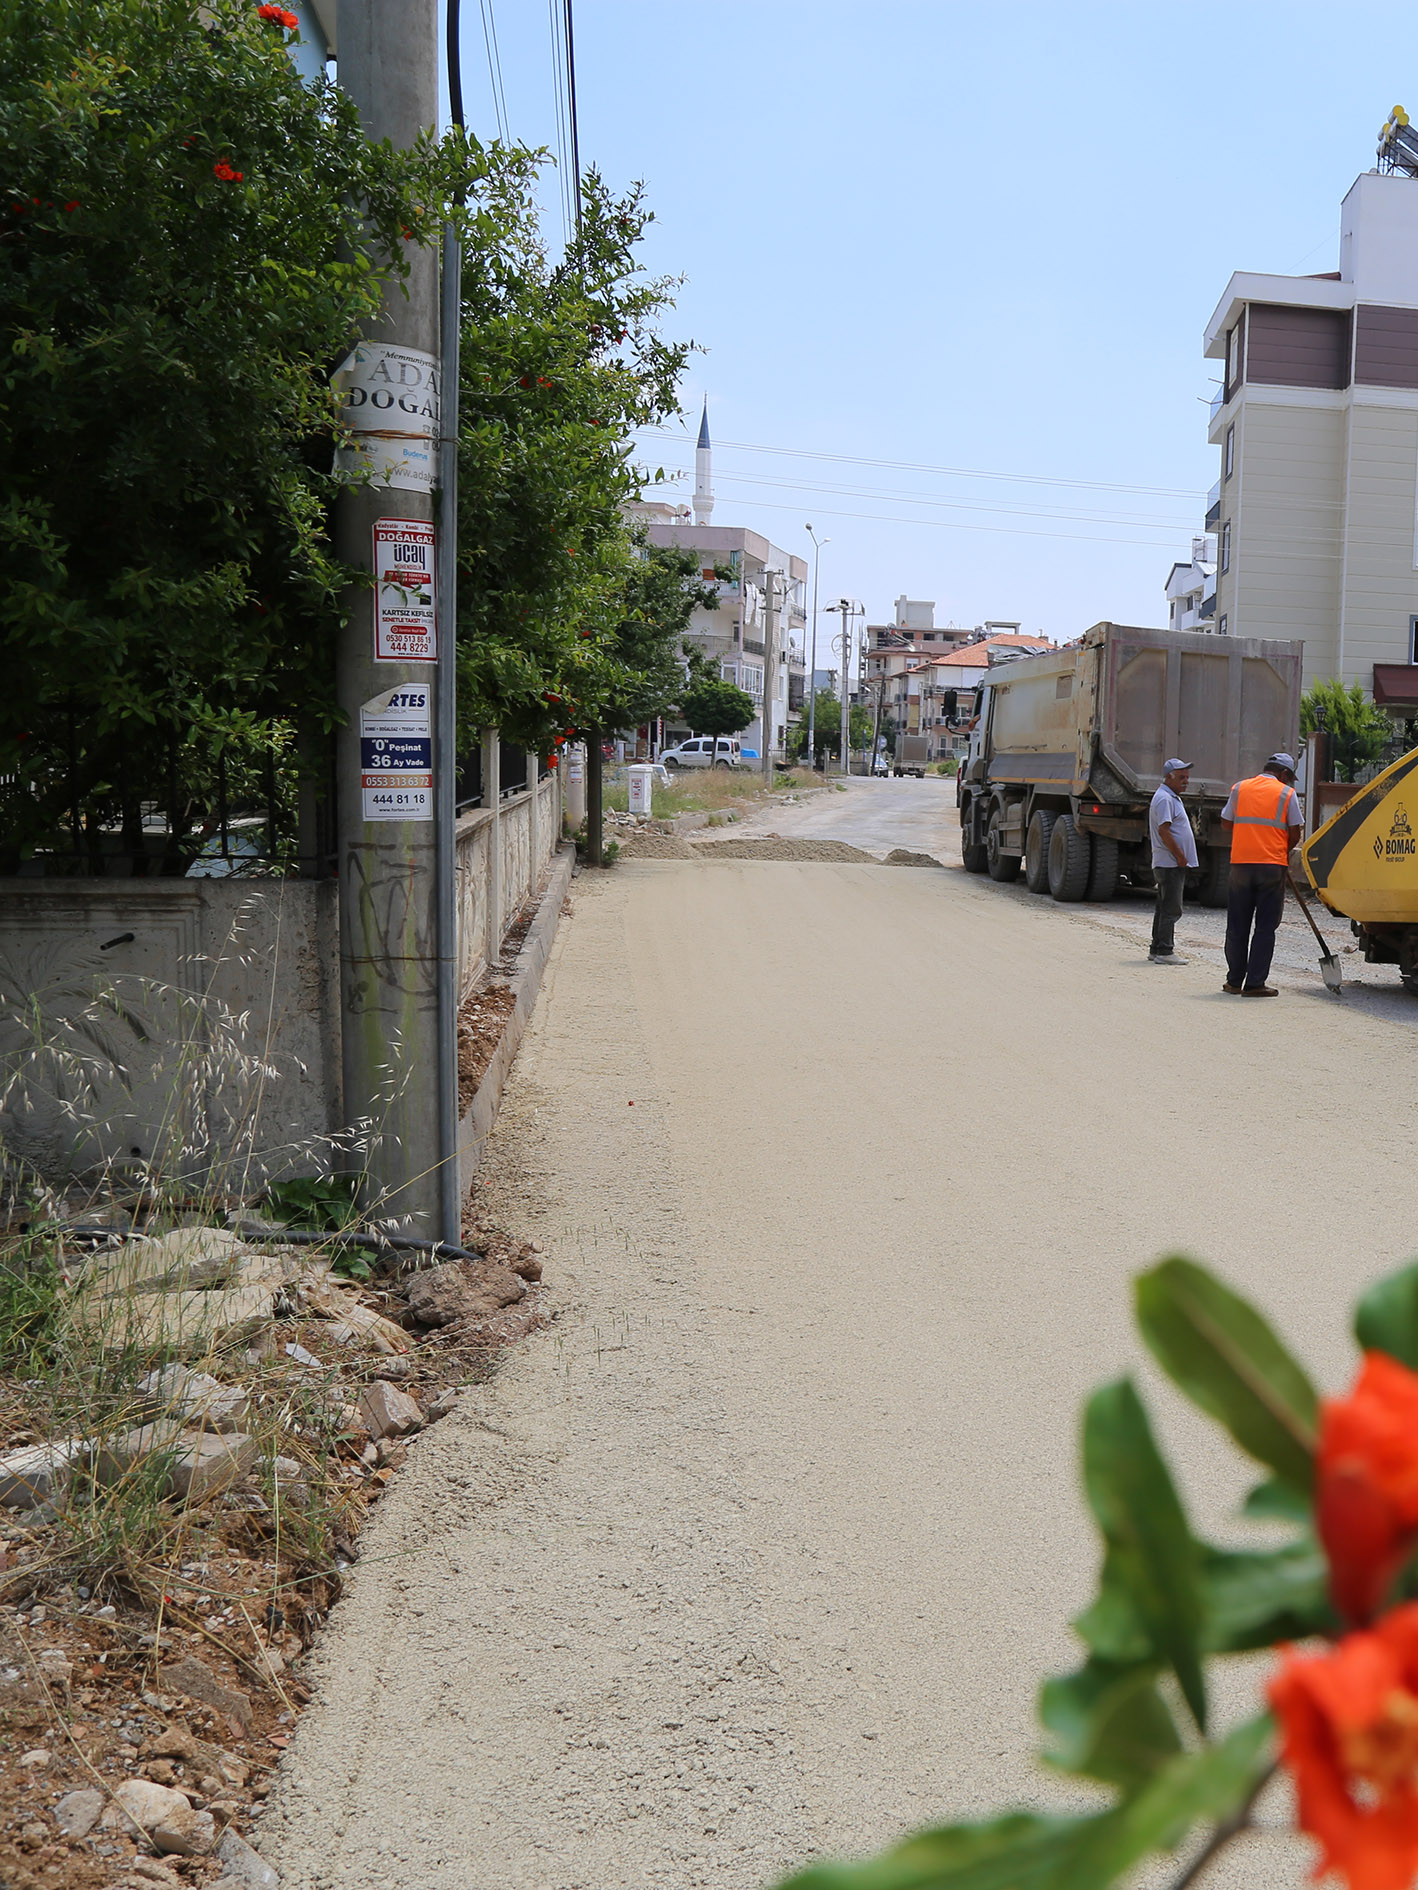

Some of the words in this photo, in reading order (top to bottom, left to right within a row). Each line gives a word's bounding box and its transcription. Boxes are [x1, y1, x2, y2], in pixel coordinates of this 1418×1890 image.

[368, 359, 440, 396] ADA
[378, 531, 433, 544] DOĞALGAZ
[390, 642, 407, 651] 444
[409, 643, 429, 652] 8229
[388, 693, 426, 707] RTES
[389, 743, 422, 753] Peşinat
[371, 754, 392, 767] 36
[393, 759, 405, 767] Ay
[366, 777, 388, 786] 0553
[389, 777, 407, 786] 313
[408, 777, 418, 786] 63
[420, 777, 430, 786] 72
[372, 794, 393, 804] 444
[396, 794, 409, 804] 81
[413, 794, 425, 804] 18
[1385, 838, 1416, 854] BOMAG
